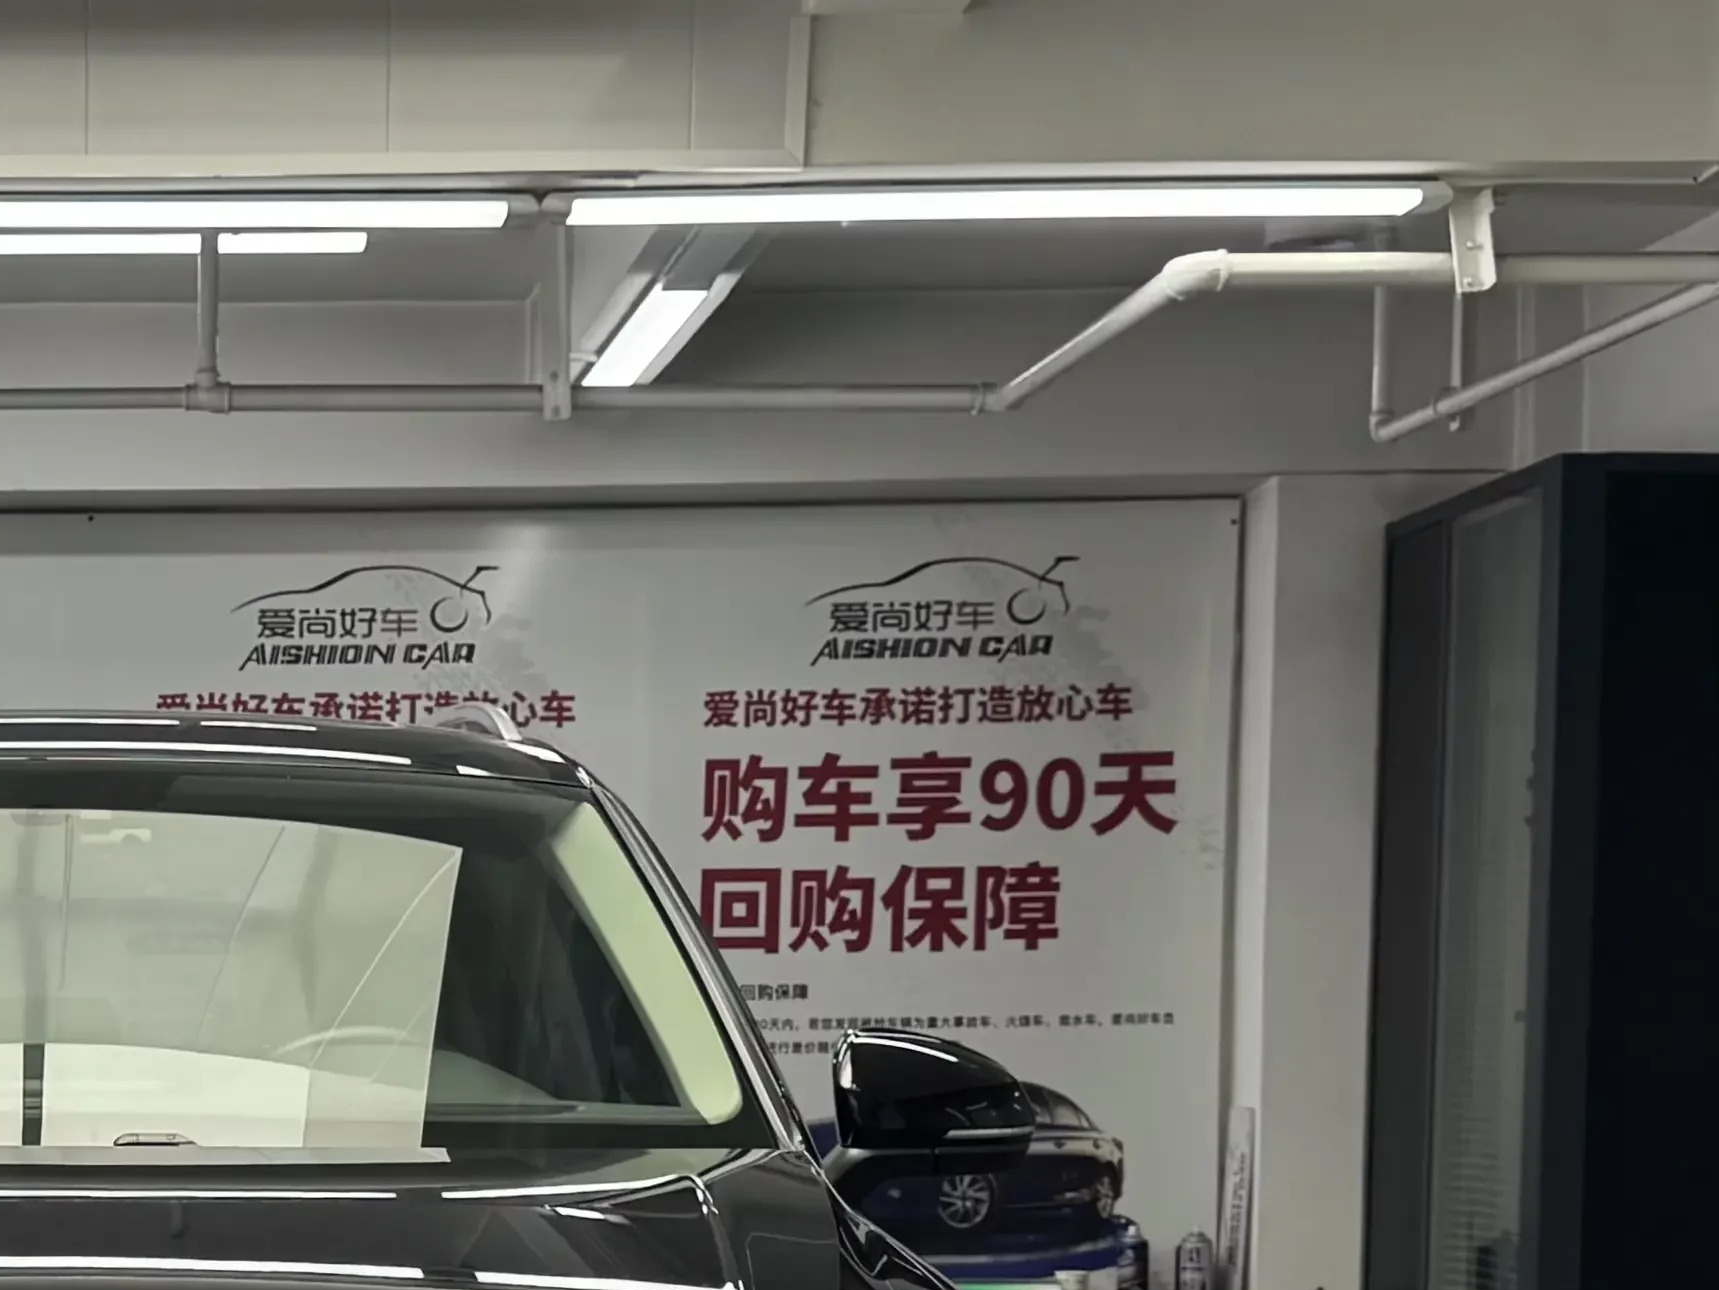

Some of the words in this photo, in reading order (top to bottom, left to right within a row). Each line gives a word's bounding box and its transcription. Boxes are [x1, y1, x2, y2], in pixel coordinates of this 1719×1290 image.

[256, 607, 419, 639] 爱尚好车
[829, 600, 996, 633] 爱尚好车
[239, 643, 396, 671] AISHION
[402, 642, 477, 670] CAR
[810, 635, 972, 666] AISHION
[978, 633, 1054, 664] CAR
[703, 683, 1133, 727] 爱尚好车承诺打造放心车
[700, 750, 1179, 843] 购车享90天
[700, 861, 1062, 955] 回购保障
